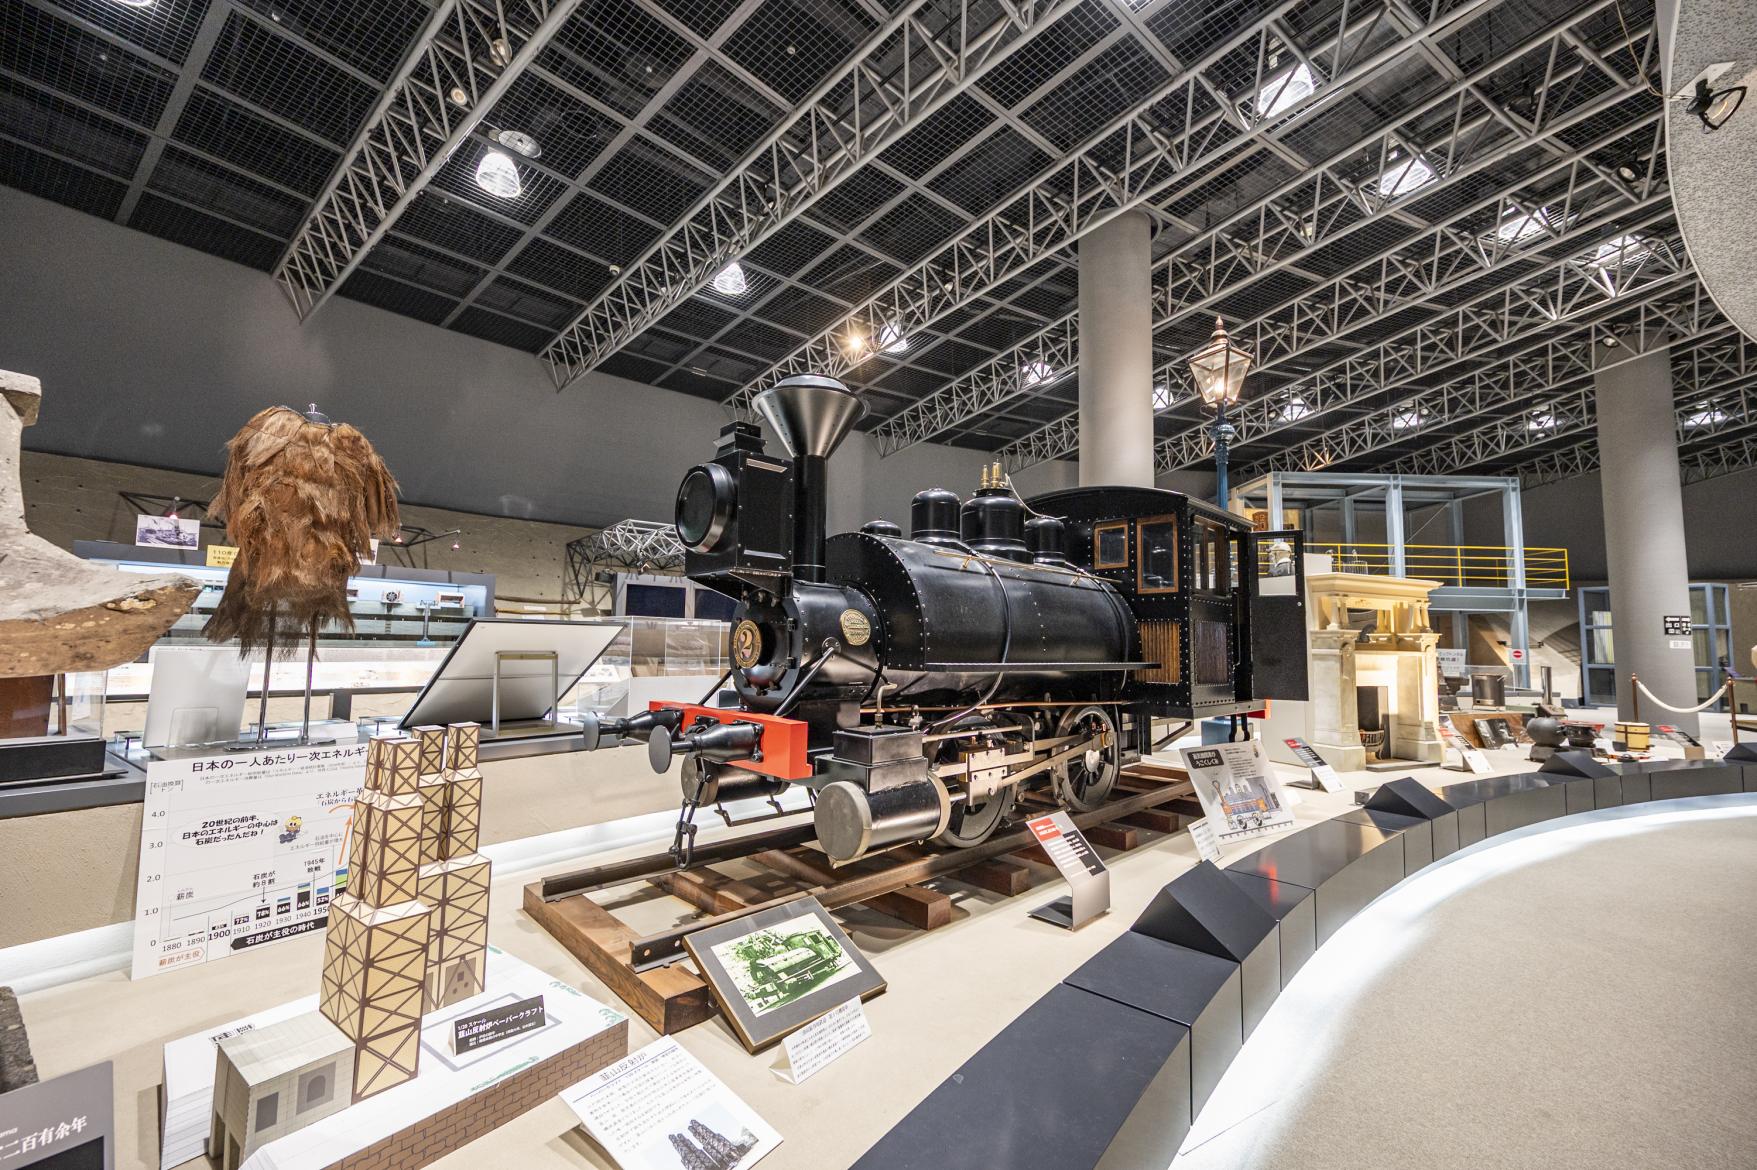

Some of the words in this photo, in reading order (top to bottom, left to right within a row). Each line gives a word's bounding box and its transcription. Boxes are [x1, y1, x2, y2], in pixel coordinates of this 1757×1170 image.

[739, 629, 753, 660] 2
[152, 810, 166, 818] 4.0
[182, 820, 278, 840] 日本のエネルギーの中心は
[149, 841, 163, 849] 3.0
[304, 858, 326, 867] 1945年
[147, 874, 161, 882] 2.0
[253, 870, 276, 880] 石炭が
[144, 907, 159, 916] 1.0
[163, 942, 182, 952] 1880
[187, 936, 206, 947] 1890
[208, 929, 230, 941] 1900
[233, 925, 250, 935] 1910
[255, 920, 272, 930] 1920
[276, 915, 292, 924] 1930
[296, 911, 312, 920] 1940
[246, 921, 315, 945] 石炭が主役の時代
[0, 1115, 87, 1160] 二百有余年
